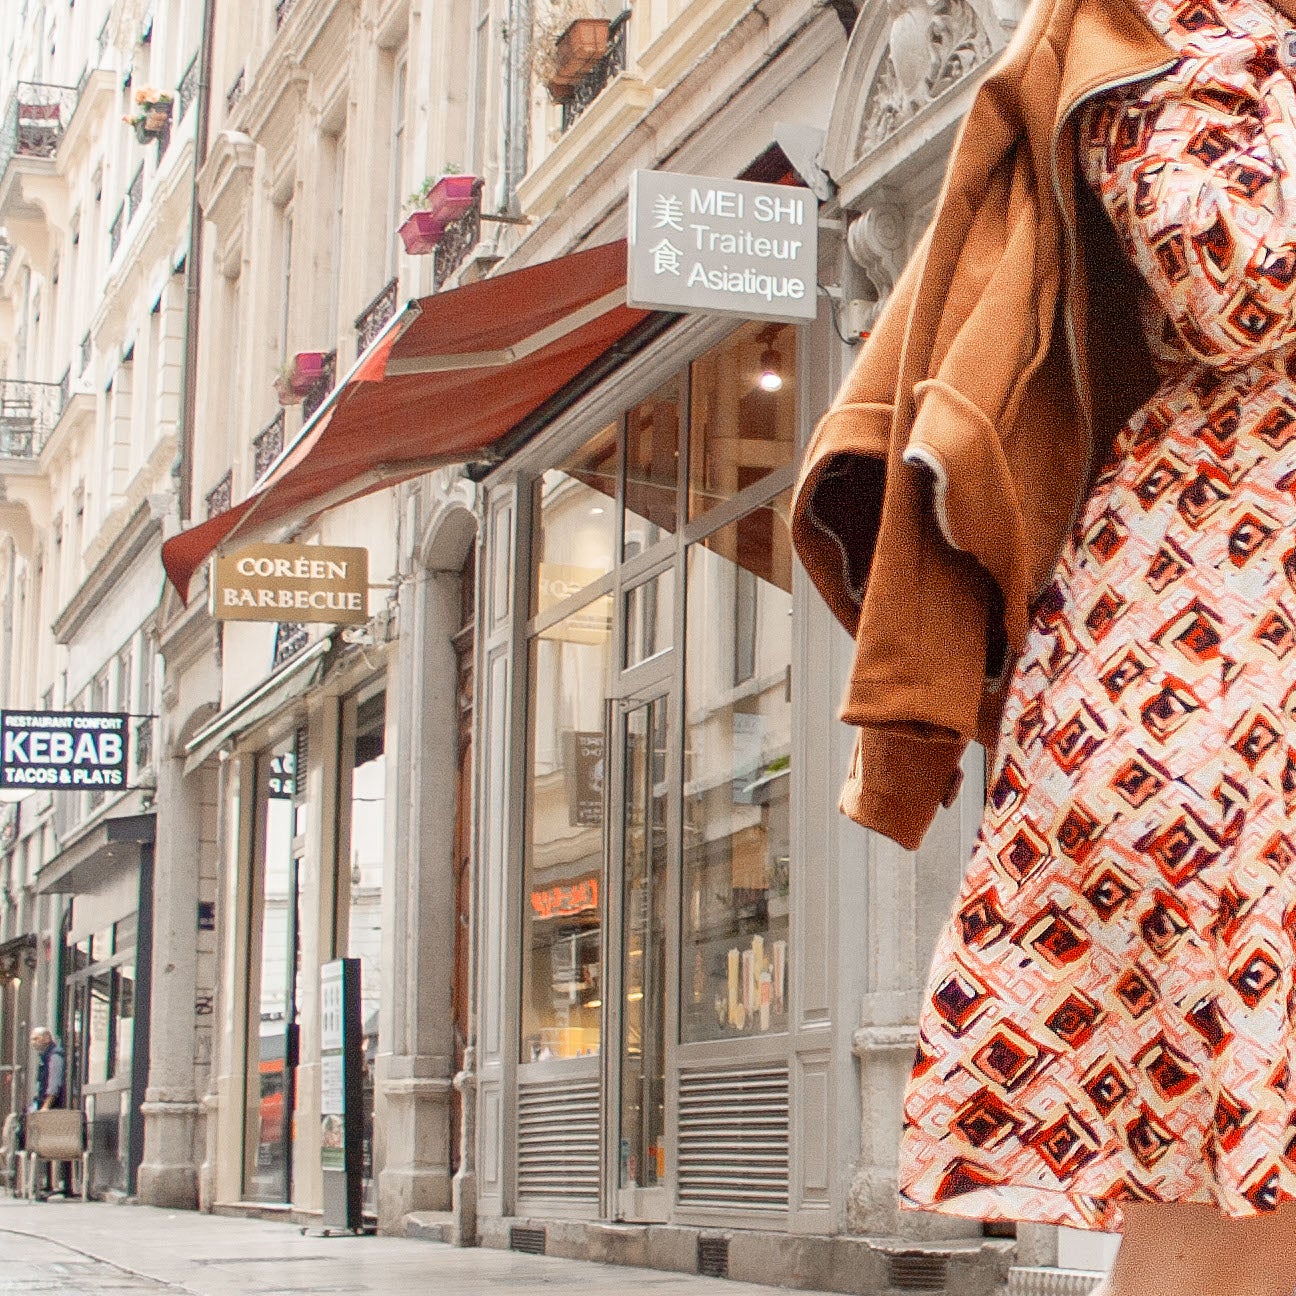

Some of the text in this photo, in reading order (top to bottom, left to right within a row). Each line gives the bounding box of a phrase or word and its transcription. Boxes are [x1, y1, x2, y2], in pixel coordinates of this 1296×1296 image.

[690, 188, 804, 226] MEI SHI
[649, 193, 684, 277] 美食
[689, 224, 803, 260] Traiteur
[687, 262, 805, 301] Asiatique
[236, 556, 349, 580] CORÉEN
[223, 587, 363, 611] BARBECUE
[5, 715, 123, 730] RESTAURANT CONFORT
[4, 730, 123, 765] KEBAB
[4, 767, 123, 785] TACOS & PLATS
